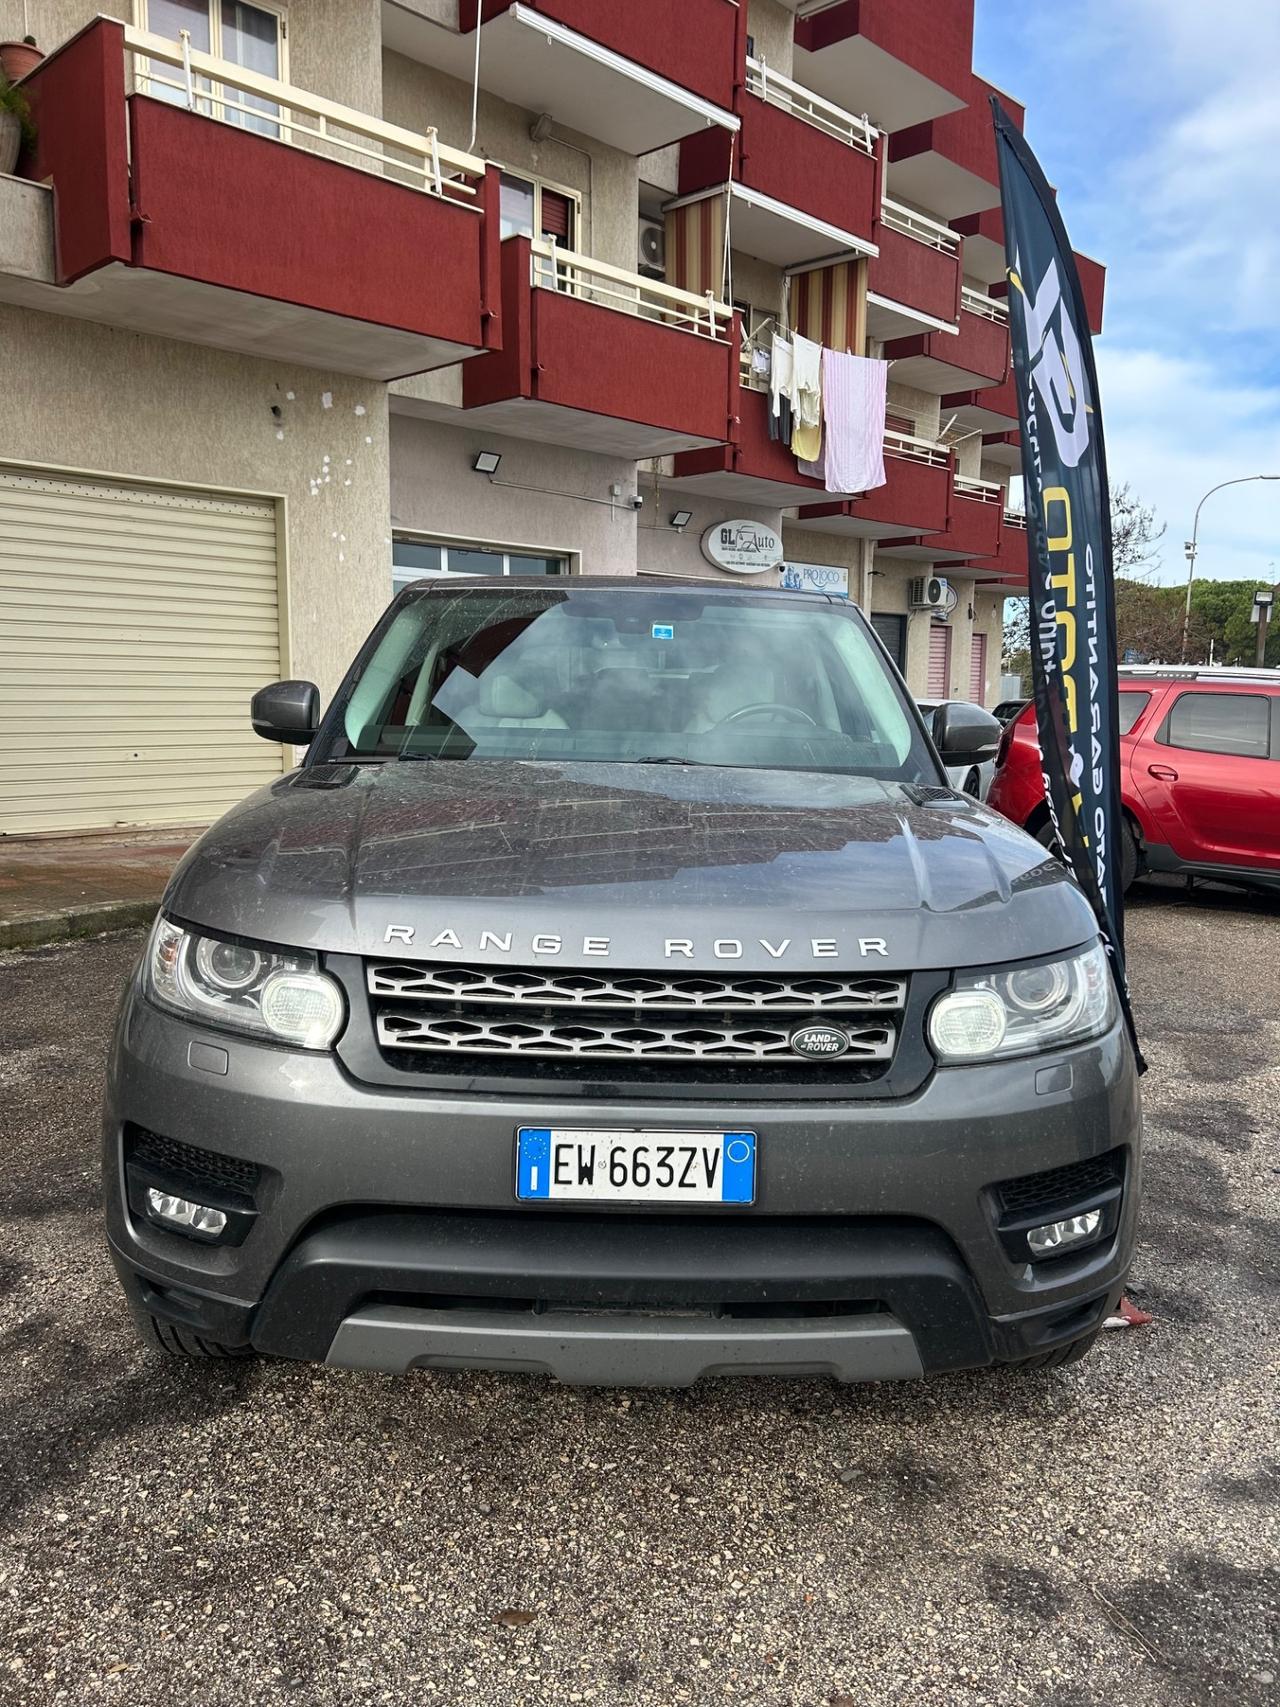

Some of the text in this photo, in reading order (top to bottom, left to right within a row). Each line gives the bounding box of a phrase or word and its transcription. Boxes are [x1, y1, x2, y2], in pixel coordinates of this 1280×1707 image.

[720, 528, 736, 545] GL
[383, 924, 890, 959] RANGE ROVER
[803, 1033, 831, 1043] LAND
[806, 1042, 839, 1052] ROVER
